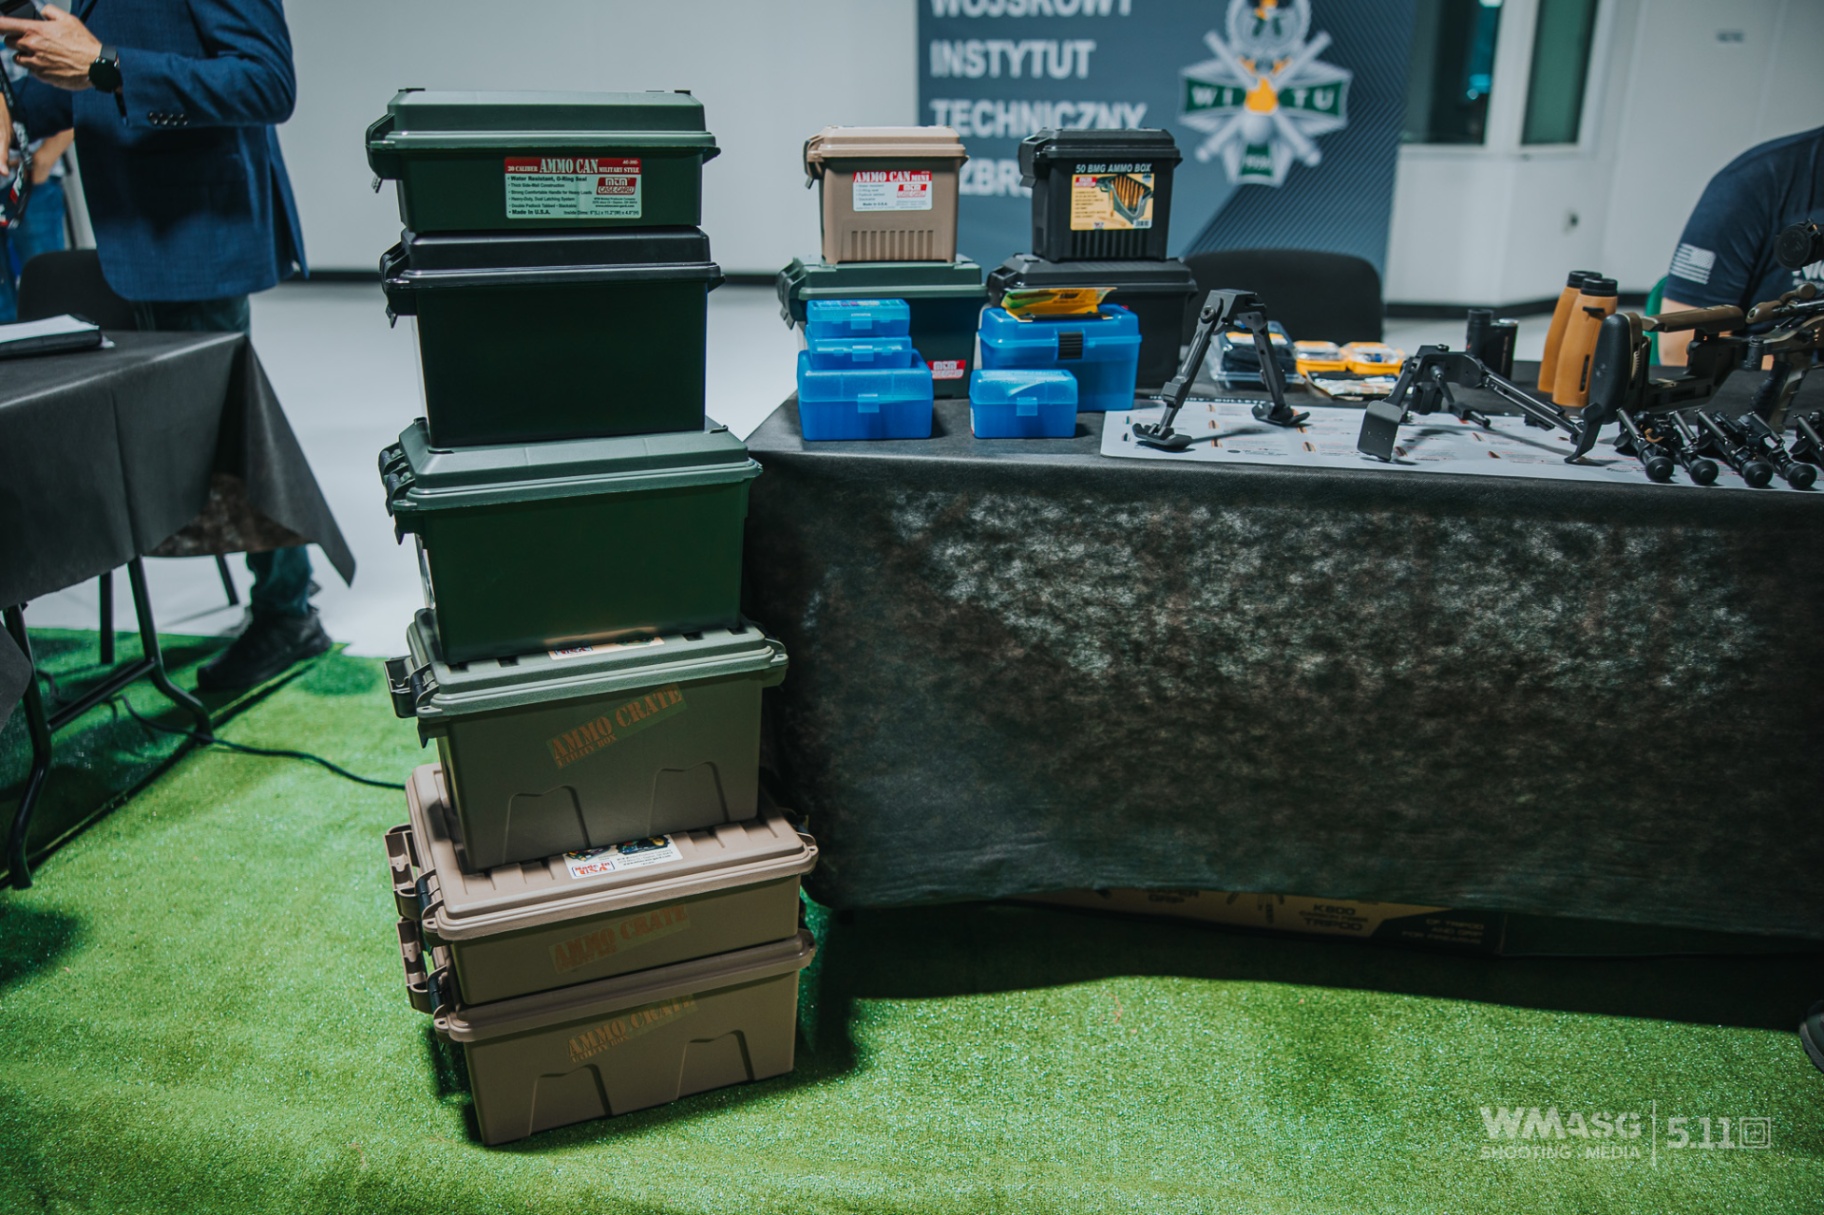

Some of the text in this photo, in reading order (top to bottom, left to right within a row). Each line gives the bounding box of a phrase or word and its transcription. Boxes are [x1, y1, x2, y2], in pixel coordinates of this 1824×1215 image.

[930, 39, 1096, 79] INSTYTUT
[929, 99, 1147, 138] TECHNICZNY
[540, 158, 574, 173] AMMO
[576, 158, 599, 173] CAN
[854, 171, 887, 183] AMMO
[889, 171, 911, 182] CAN
[1075, 163, 1152, 173] 50 BMG AMMO BOX
[552, 689, 682, 759] AMMO CRATE
[555, 928, 615, 965] AMMO
[620, 905, 688, 940] CRATE
[1304, 917, 1362, 931] TRIPOD
[1445, 921, 1484, 930] TRIPOD
[568, 1019, 626, 1056] AMMO
